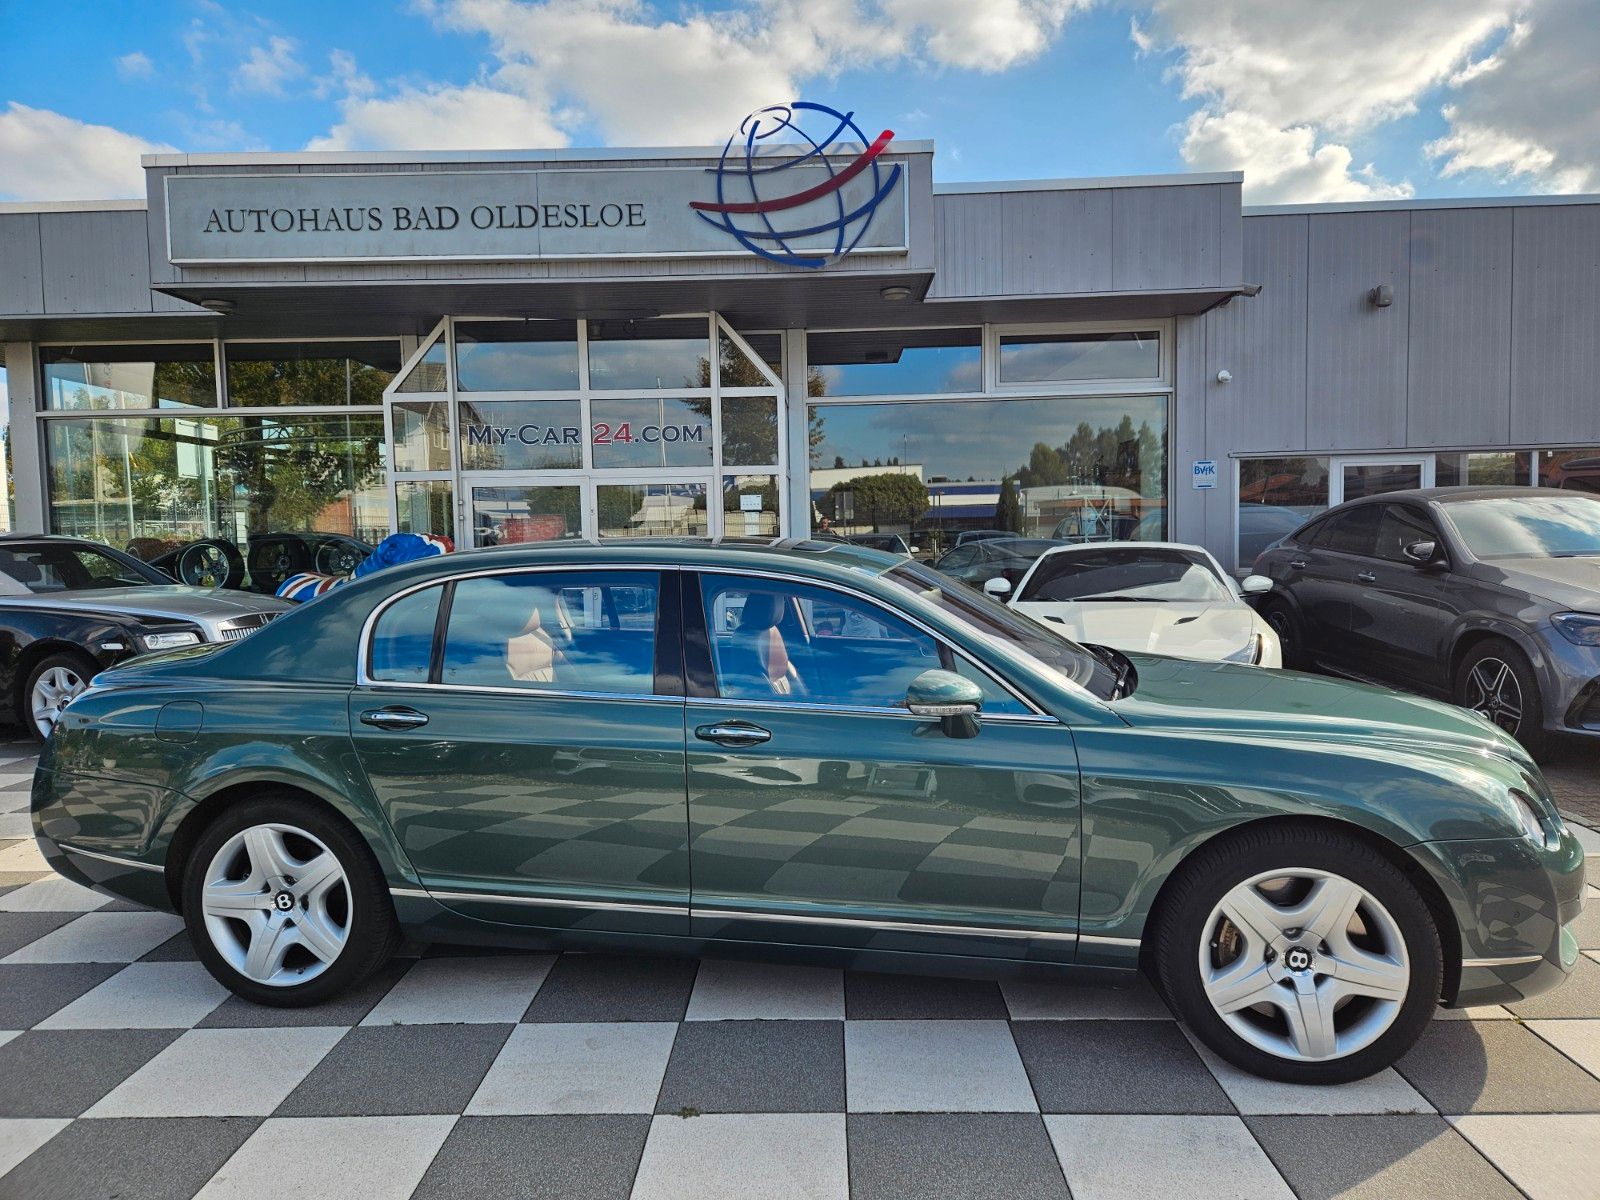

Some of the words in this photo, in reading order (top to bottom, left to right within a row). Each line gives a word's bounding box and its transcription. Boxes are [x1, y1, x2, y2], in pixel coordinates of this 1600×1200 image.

[203, 207, 383, 233] AUTOHAUS
[393, 206, 460, 230] BAD
[470, 203, 647, 229] OLDESLOE
